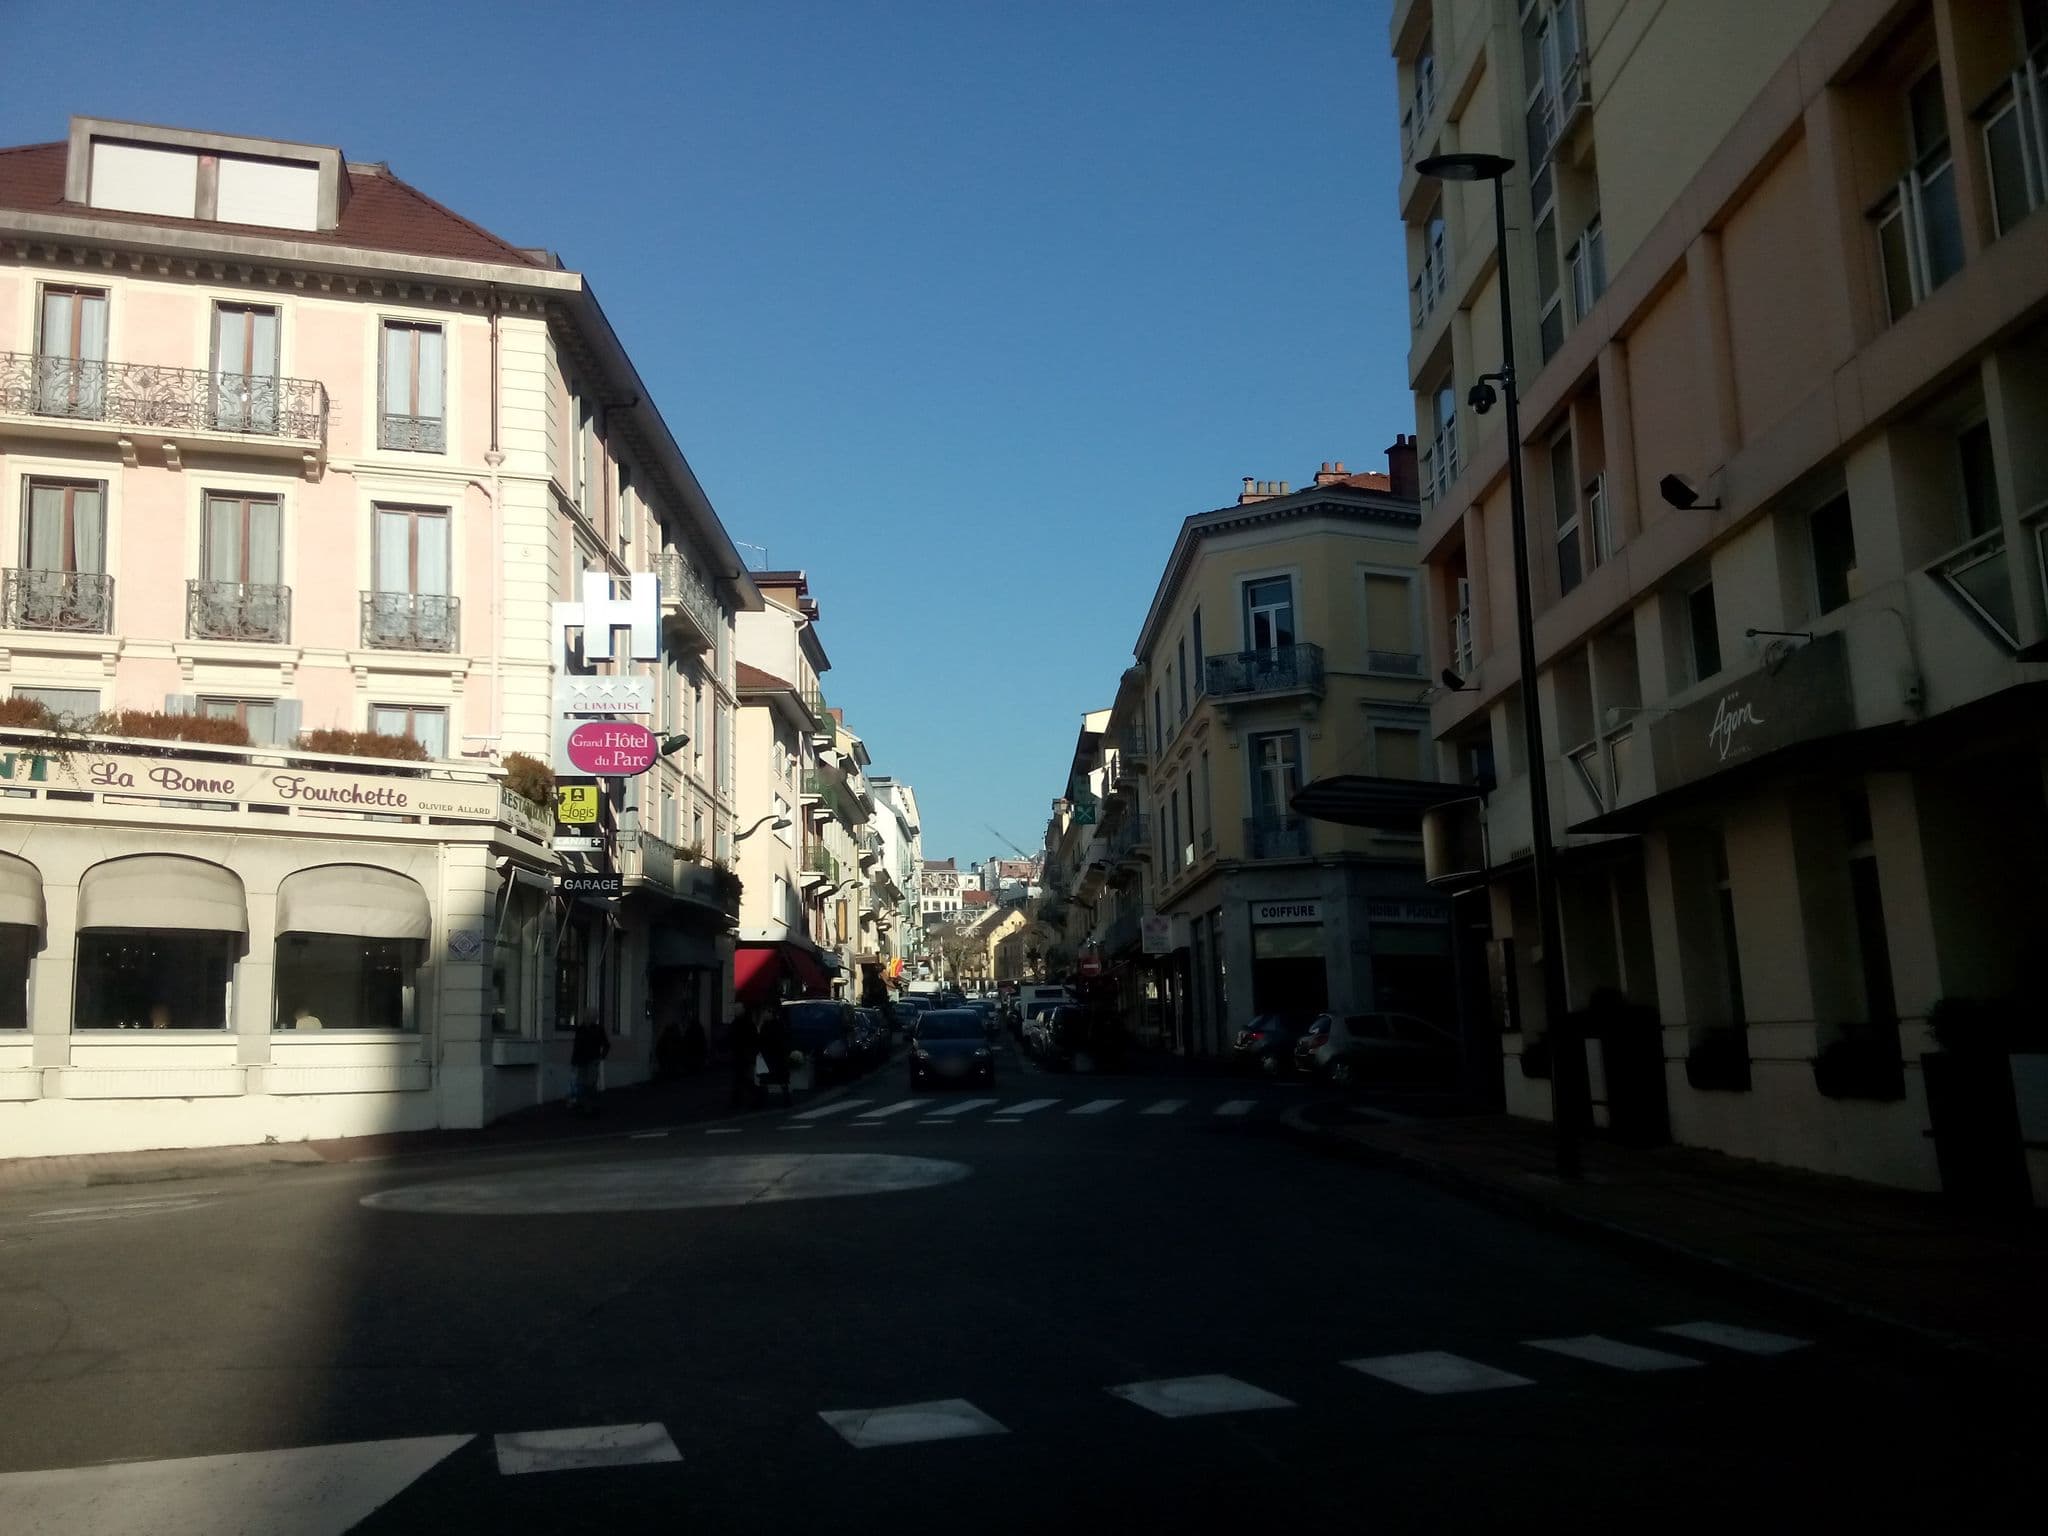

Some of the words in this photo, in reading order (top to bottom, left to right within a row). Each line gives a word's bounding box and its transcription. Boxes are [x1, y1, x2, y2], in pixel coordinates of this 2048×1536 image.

[582, 571, 660, 662] H
[1709, 697, 1765, 762] Agora
[571, 734, 602, 748] Grand
[605, 732, 648, 748] Hôtel
[594, 755, 609, 766] du
[613, 751, 648, 766] Parc
[90, 762, 135, 788] La
[148, 767, 235, 794] Bonne
[272, 775, 408, 808] Fourchette
[419, 801, 453, 812] OLIVIER
[458, 805, 491, 815] ALLARD
[560, 802, 595, 821] Logis
[564, 879, 618, 890] GARAGE
[1261, 904, 1315, 918] COIFFURE
